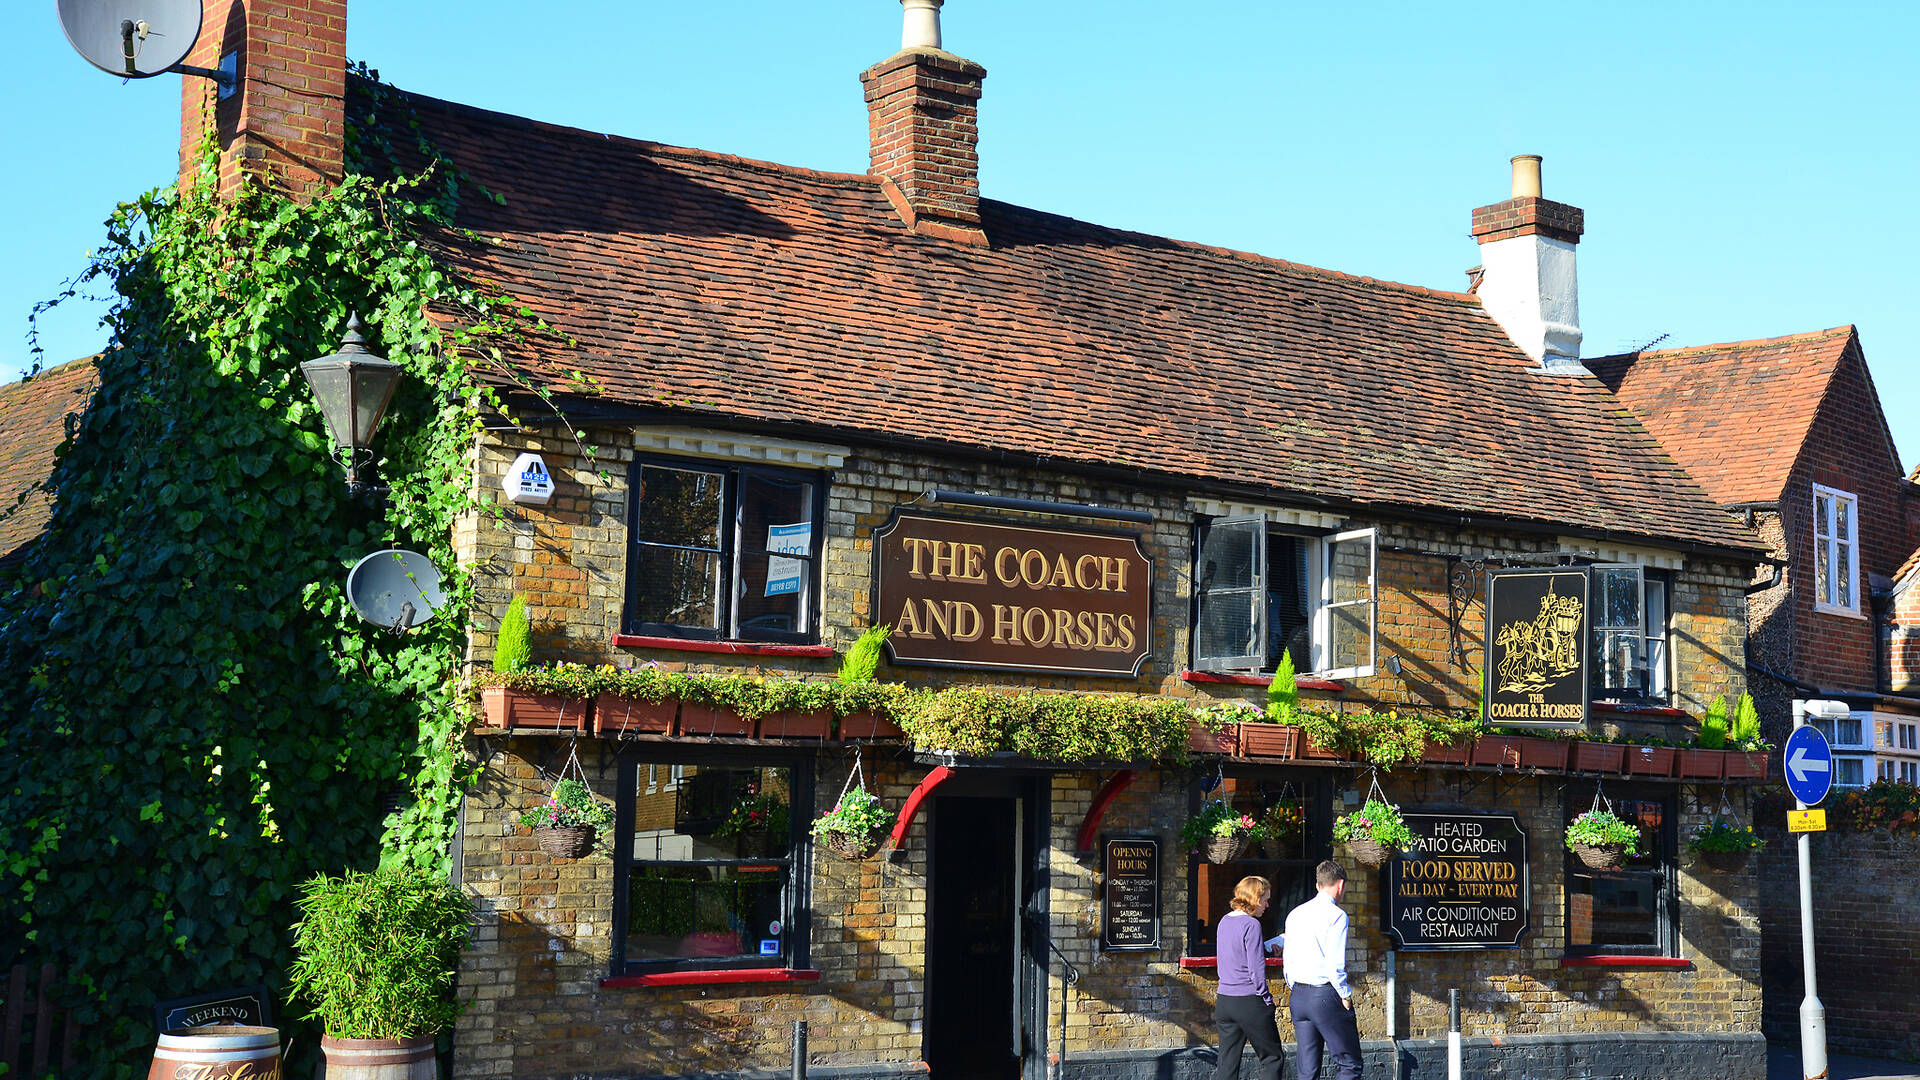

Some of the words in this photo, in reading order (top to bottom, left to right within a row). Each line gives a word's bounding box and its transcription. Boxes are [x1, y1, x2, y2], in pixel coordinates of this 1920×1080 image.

[903, 537, 987, 584] THE
[994, 546, 1131, 593] COACH
[894, 597, 985, 642] AND
[992, 604, 1136, 654] HORSES
[1528, 693, 1544, 703] THE
[1491, 703, 1529, 717] COACH
[1530, 703, 1539, 717] &
[1540, 704, 1583, 718] HORSES
[1434, 822, 1483, 837] HEATED
[1113, 847, 1152, 857] OPENING
[1410, 838, 1448, 852] PATIO
[1452, 838, 1507, 853] GARDEN
[1117, 859, 1148, 870] HOURS
[1401, 860, 1450, 880] FOOD
[1453, 861, 1516, 881] SERVED
[1399, 883, 1421, 897] ALL
[1423, 883, 1447, 897] DAY
[1458, 883, 1494, 897] EVERY
[1495, 883, 1519, 898] DAY
[1402, 907, 1422, 921] AIR
[1426, 907, 1517, 921] CONDITIONED
[1420, 923, 1499, 937] RESTAURANT
[181, 1007, 248, 1028] WEEKEND
